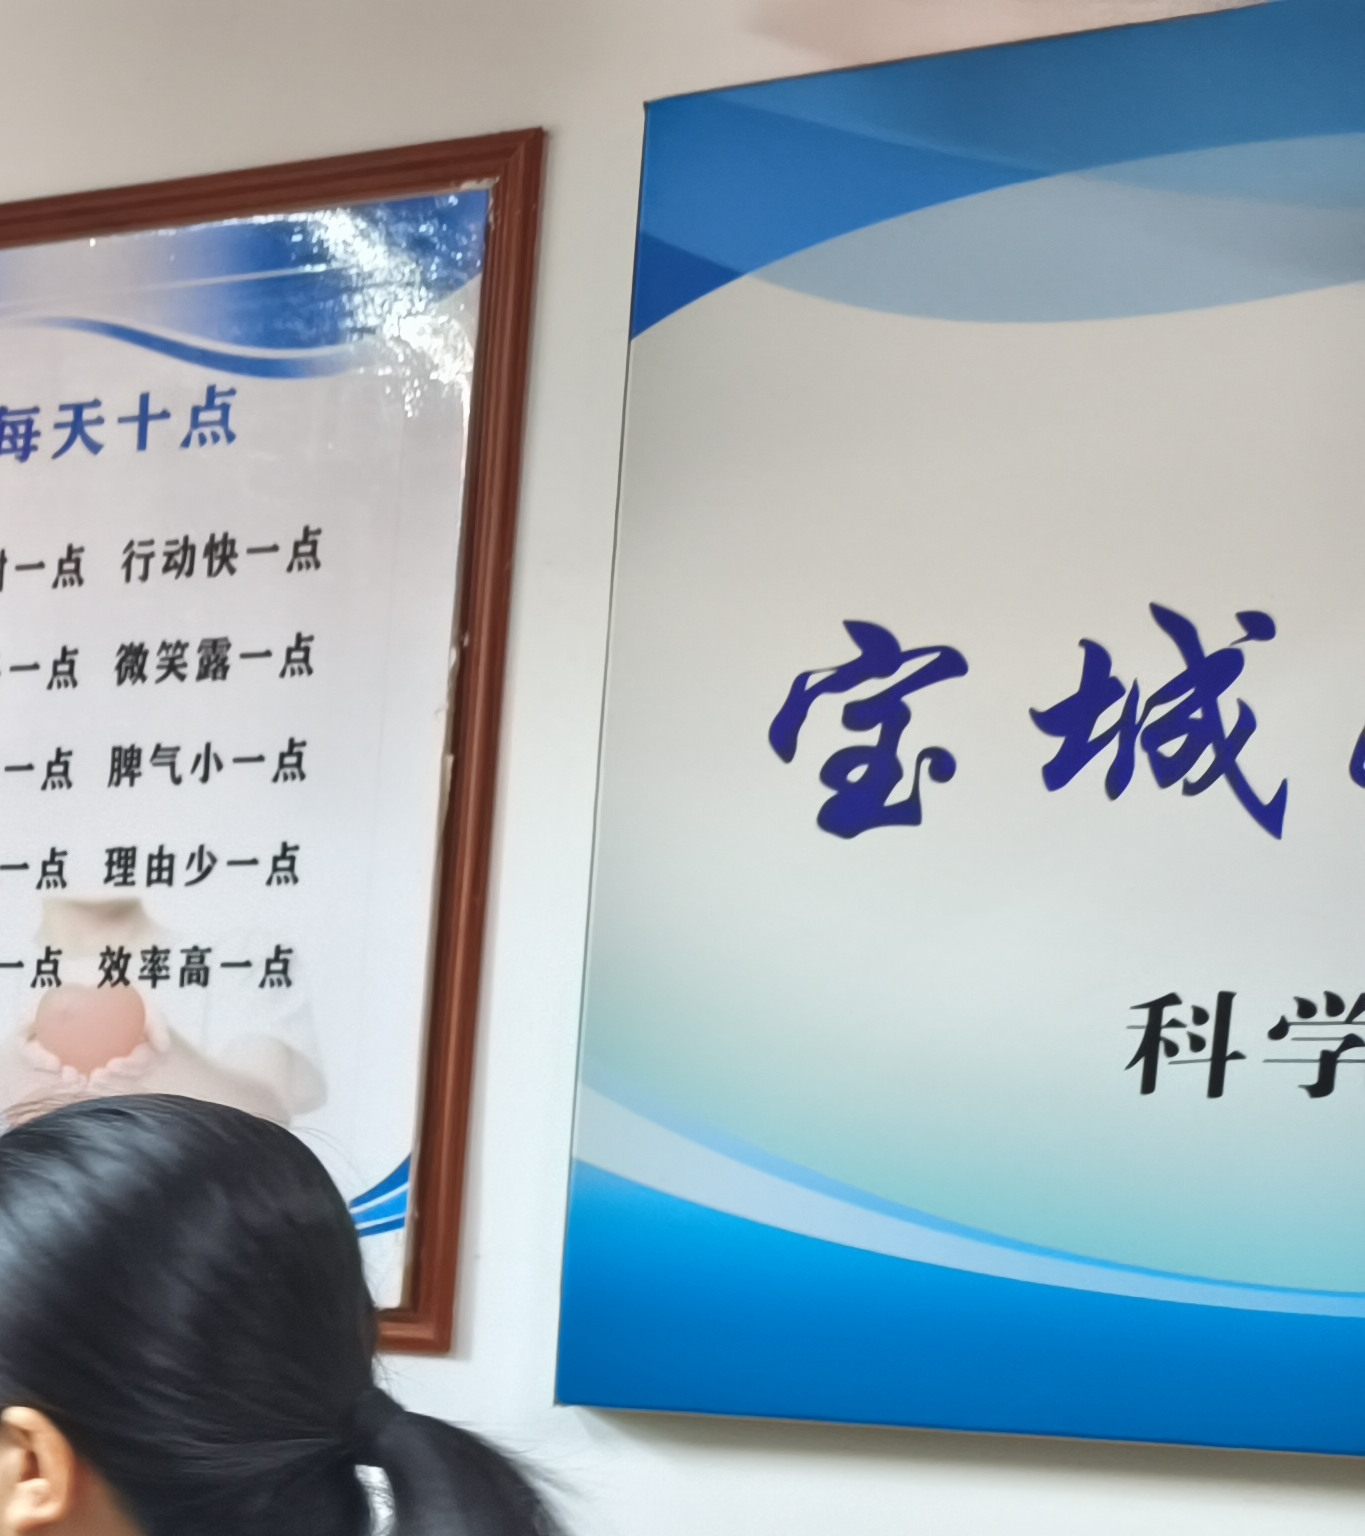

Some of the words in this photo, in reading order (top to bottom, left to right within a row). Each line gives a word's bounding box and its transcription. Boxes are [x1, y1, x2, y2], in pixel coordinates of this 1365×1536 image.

[121, 525, 323, 584] 行动快一点
[115, 632, 315, 687] 微笑露一点
[768, 602, 1365, 840] 宝城
[108, 736, 308, 788] 脾气小一点
[103, 840, 300, 888] 理由少一点
[97, 943, 294, 990] 效率高一点
[1124, 990, 1365, 1100] 科学
